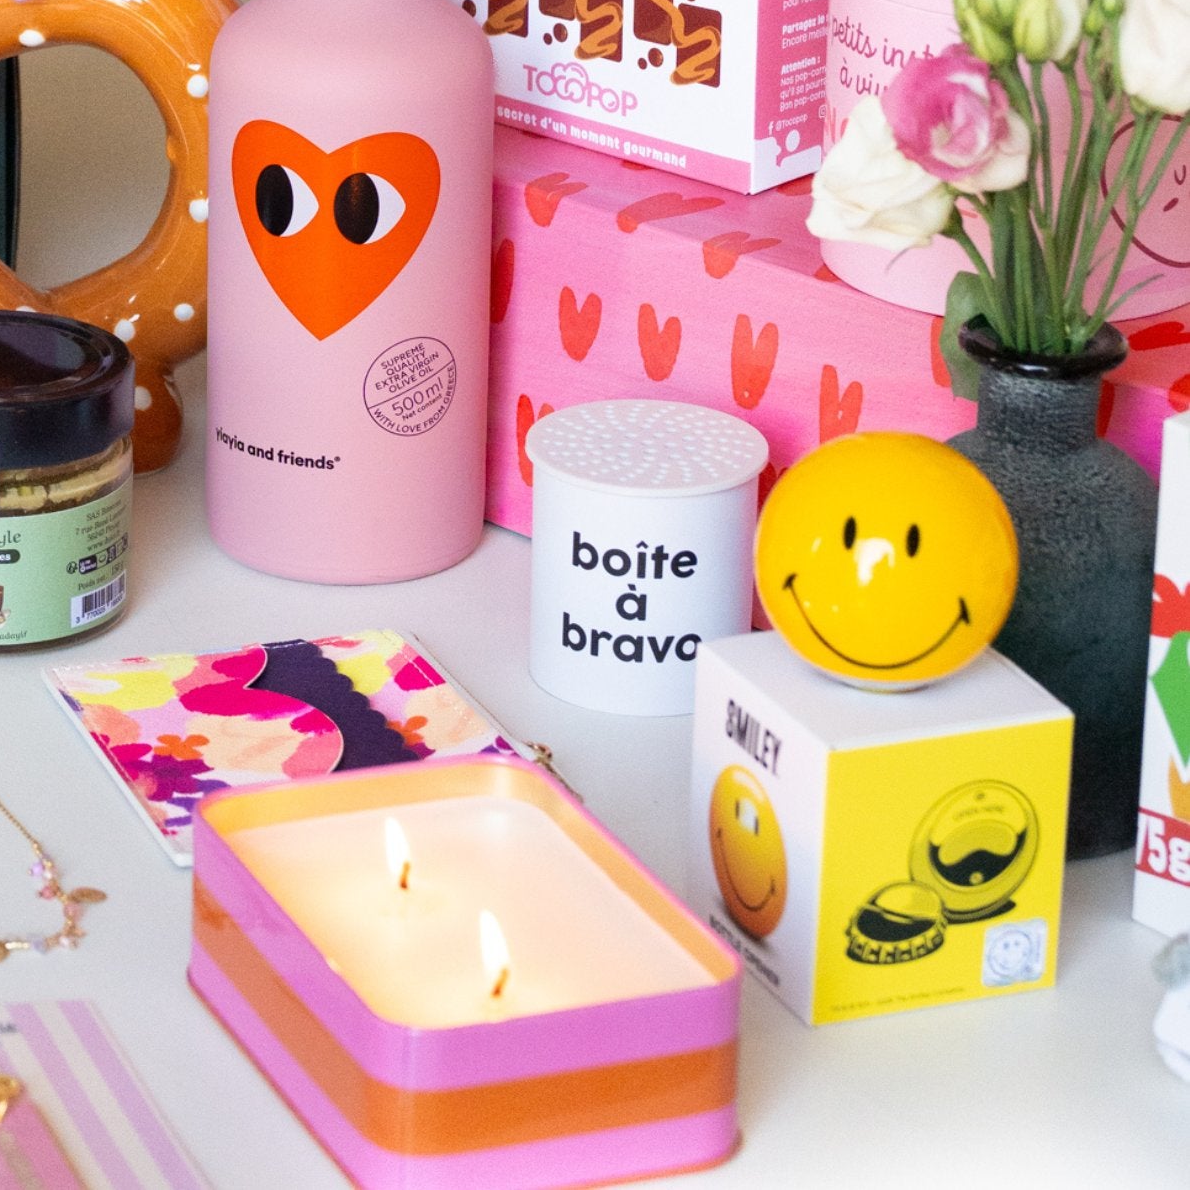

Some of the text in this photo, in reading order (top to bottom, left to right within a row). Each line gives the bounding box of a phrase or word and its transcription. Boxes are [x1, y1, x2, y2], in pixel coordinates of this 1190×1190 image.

[840, 58, 852, 88] à
[540, 116, 567, 136] d'un
[570, 125, 620, 150] moment
[623, 140, 686, 169] gourmand
[375, 351, 439, 391] EXTRA VIRGIN
[381, 342, 425, 370] SUPREME
[386, 350, 426, 376] QUALITY
[389, 365, 433, 393] OLIVE OIL
[374, 365, 455, 433] WITH LOVE FROM GREECE
[402, 393, 442, 421] Net content
[215, 426, 245, 453] yiayia
[247, 443, 274, 461] and
[572, 531, 698, 579] boîte
[615, 584, 647, 621] à
[562, 612, 702, 663] bravo
[725, 698, 782, 777] SMILEY
